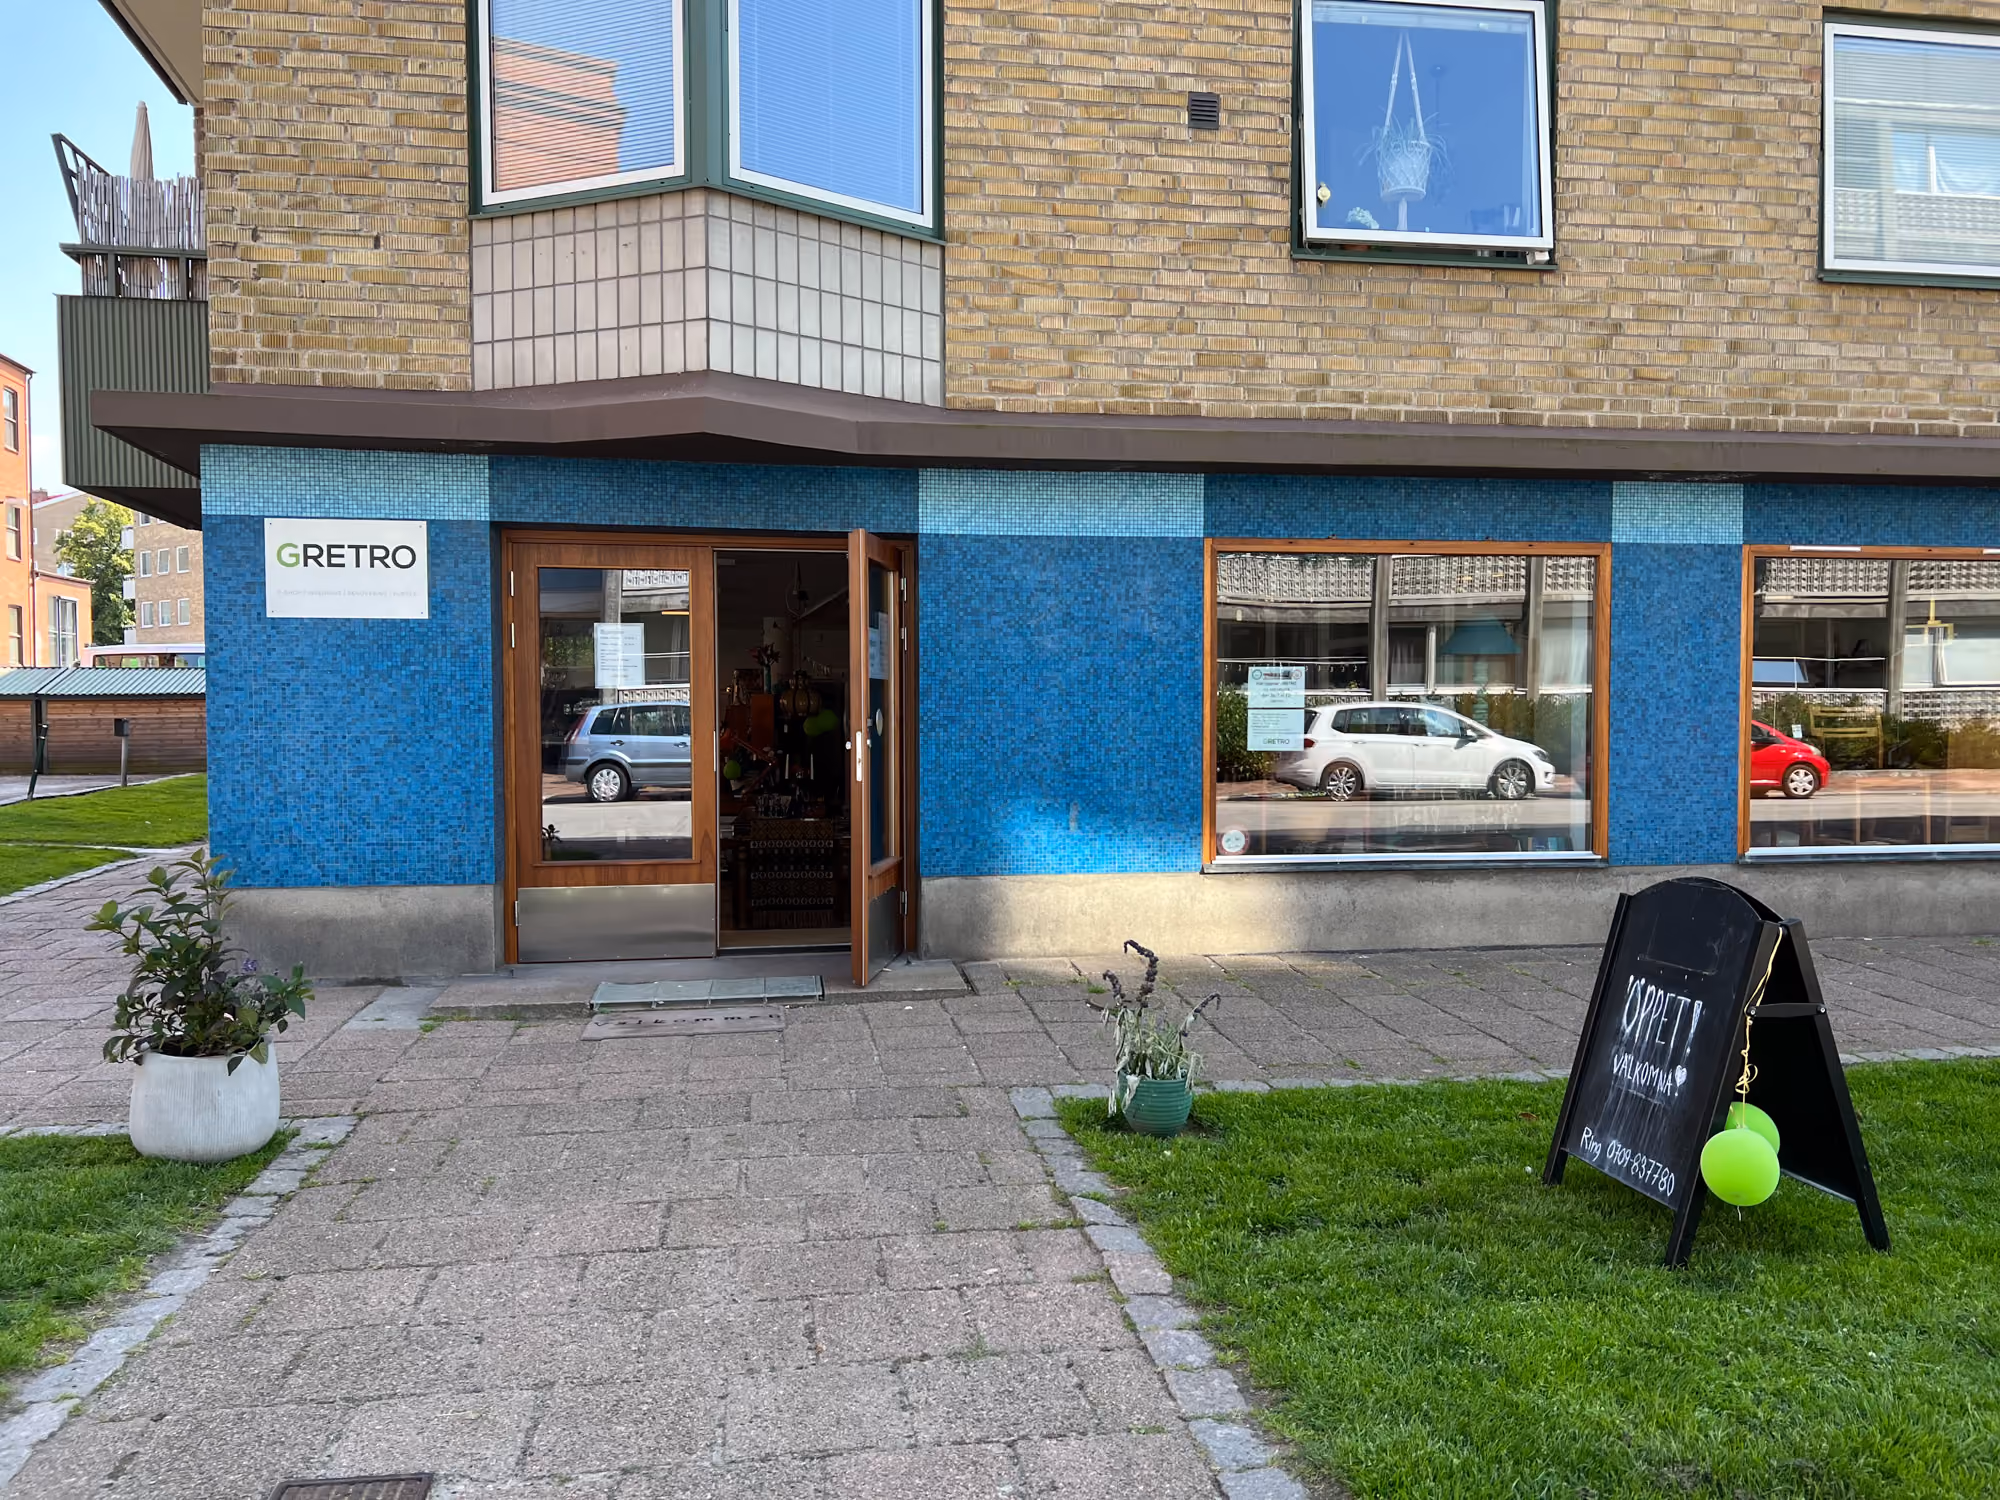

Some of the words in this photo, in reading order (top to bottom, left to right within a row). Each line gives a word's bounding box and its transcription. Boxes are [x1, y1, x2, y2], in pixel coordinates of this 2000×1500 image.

[276, 542, 417, 569] GRETRO
[1620, 974, 1704, 1057] ÖPPET!
[1579, 1126, 1602, 1162] Ring
[1606, 1139, 1676, 1197] 0709-837780
